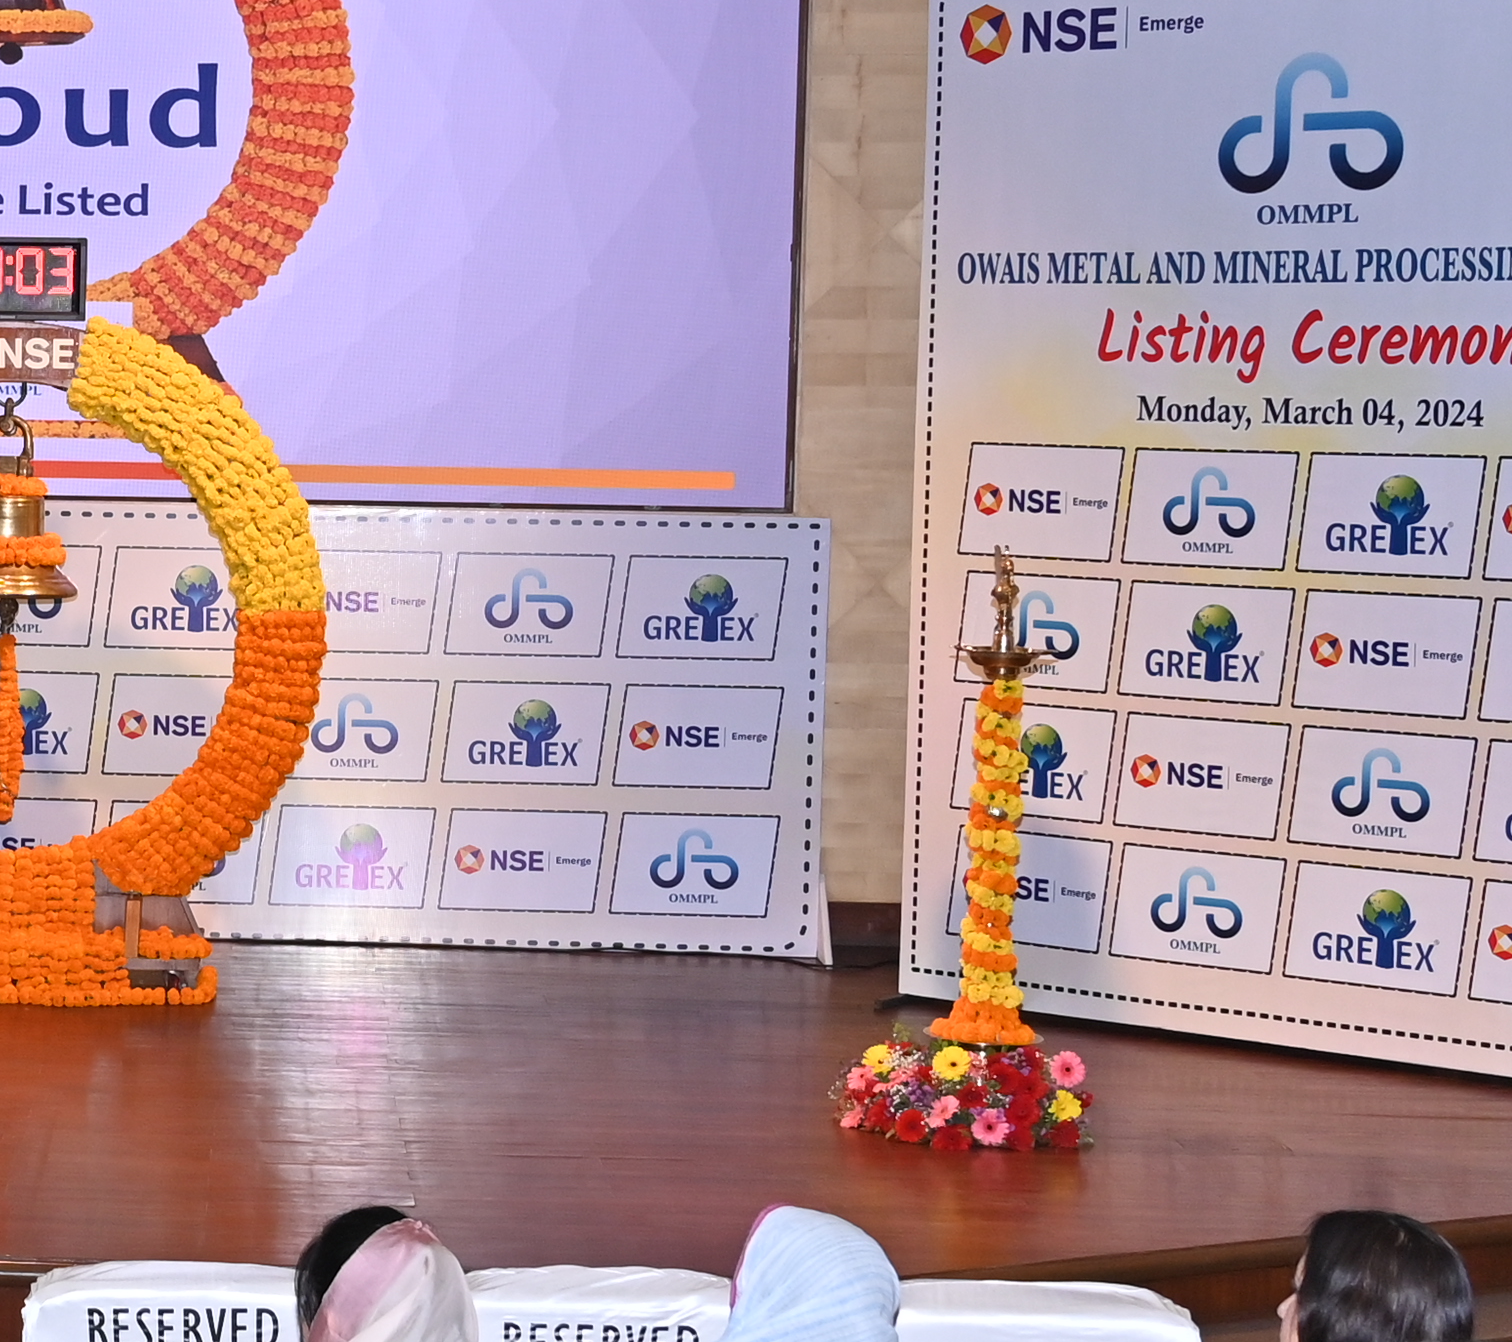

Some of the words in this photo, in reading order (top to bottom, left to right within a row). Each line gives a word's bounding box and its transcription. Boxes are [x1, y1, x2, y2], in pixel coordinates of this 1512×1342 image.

[1022, 7, 1118, 54] NSE
[1139, 12, 1205, 33] Emerge
[18, 183, 150, 217] Listed
[1256, 202, 1359, 226] OMMPL
[957, 251, 1040, 285] OWAIS
[1047, 251, 1141, 284] METAL
[1146, 251, 1205, 284] AND
[1213, 249, 1348, 284] MINERAL
[1098, 308, 1265, 384] Listing
[1136, 395, 1253, 431] Monday,
[1262, 397, 1353, 426] March
[1363, 398, 1404, 433] 04,
[1415, 399, 1484, 427] 2024
[1008, 488, 1061, 514] NSE
[1182, 541, 1234, 554] OMMPL
[325, 590, 379, 613] NSE
[504, 633, 553, 645] OMMPL
[1349, 640, 1409, 667] NSE
[153, 713, 207, 737] NSE
[665, 725, 720, 749] NSE
[1167, 762, 1223, 789] NSE
[1351, 823, 1407, 839] OMMPL
[489, 849, 544, 872] NSE
[1169, 939, 1221, 954] OMMPL
